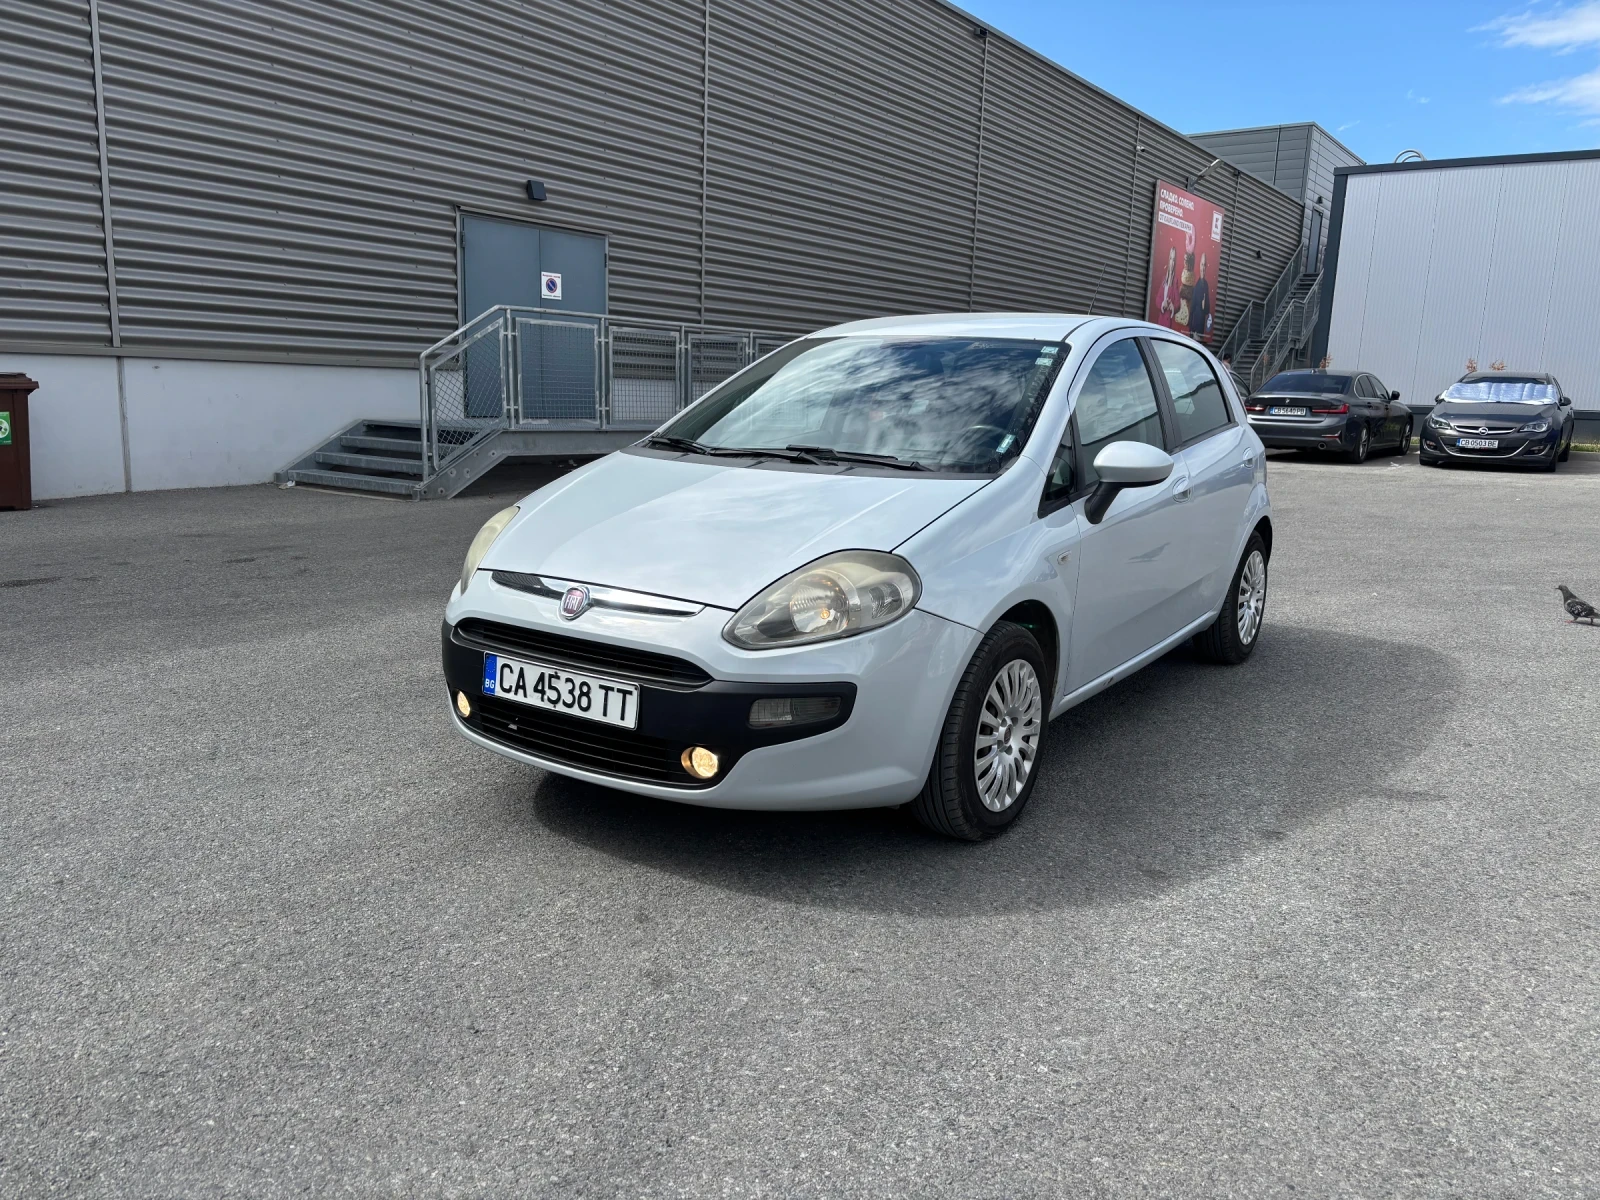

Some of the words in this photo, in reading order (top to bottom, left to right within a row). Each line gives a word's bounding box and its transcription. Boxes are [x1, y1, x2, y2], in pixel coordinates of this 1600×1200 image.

[484, 678, 495, 689] BG
[499, 662, 528, 698] CA
[533, 670, 592, 713] 4538
[598, 683, 633, 722] TT
